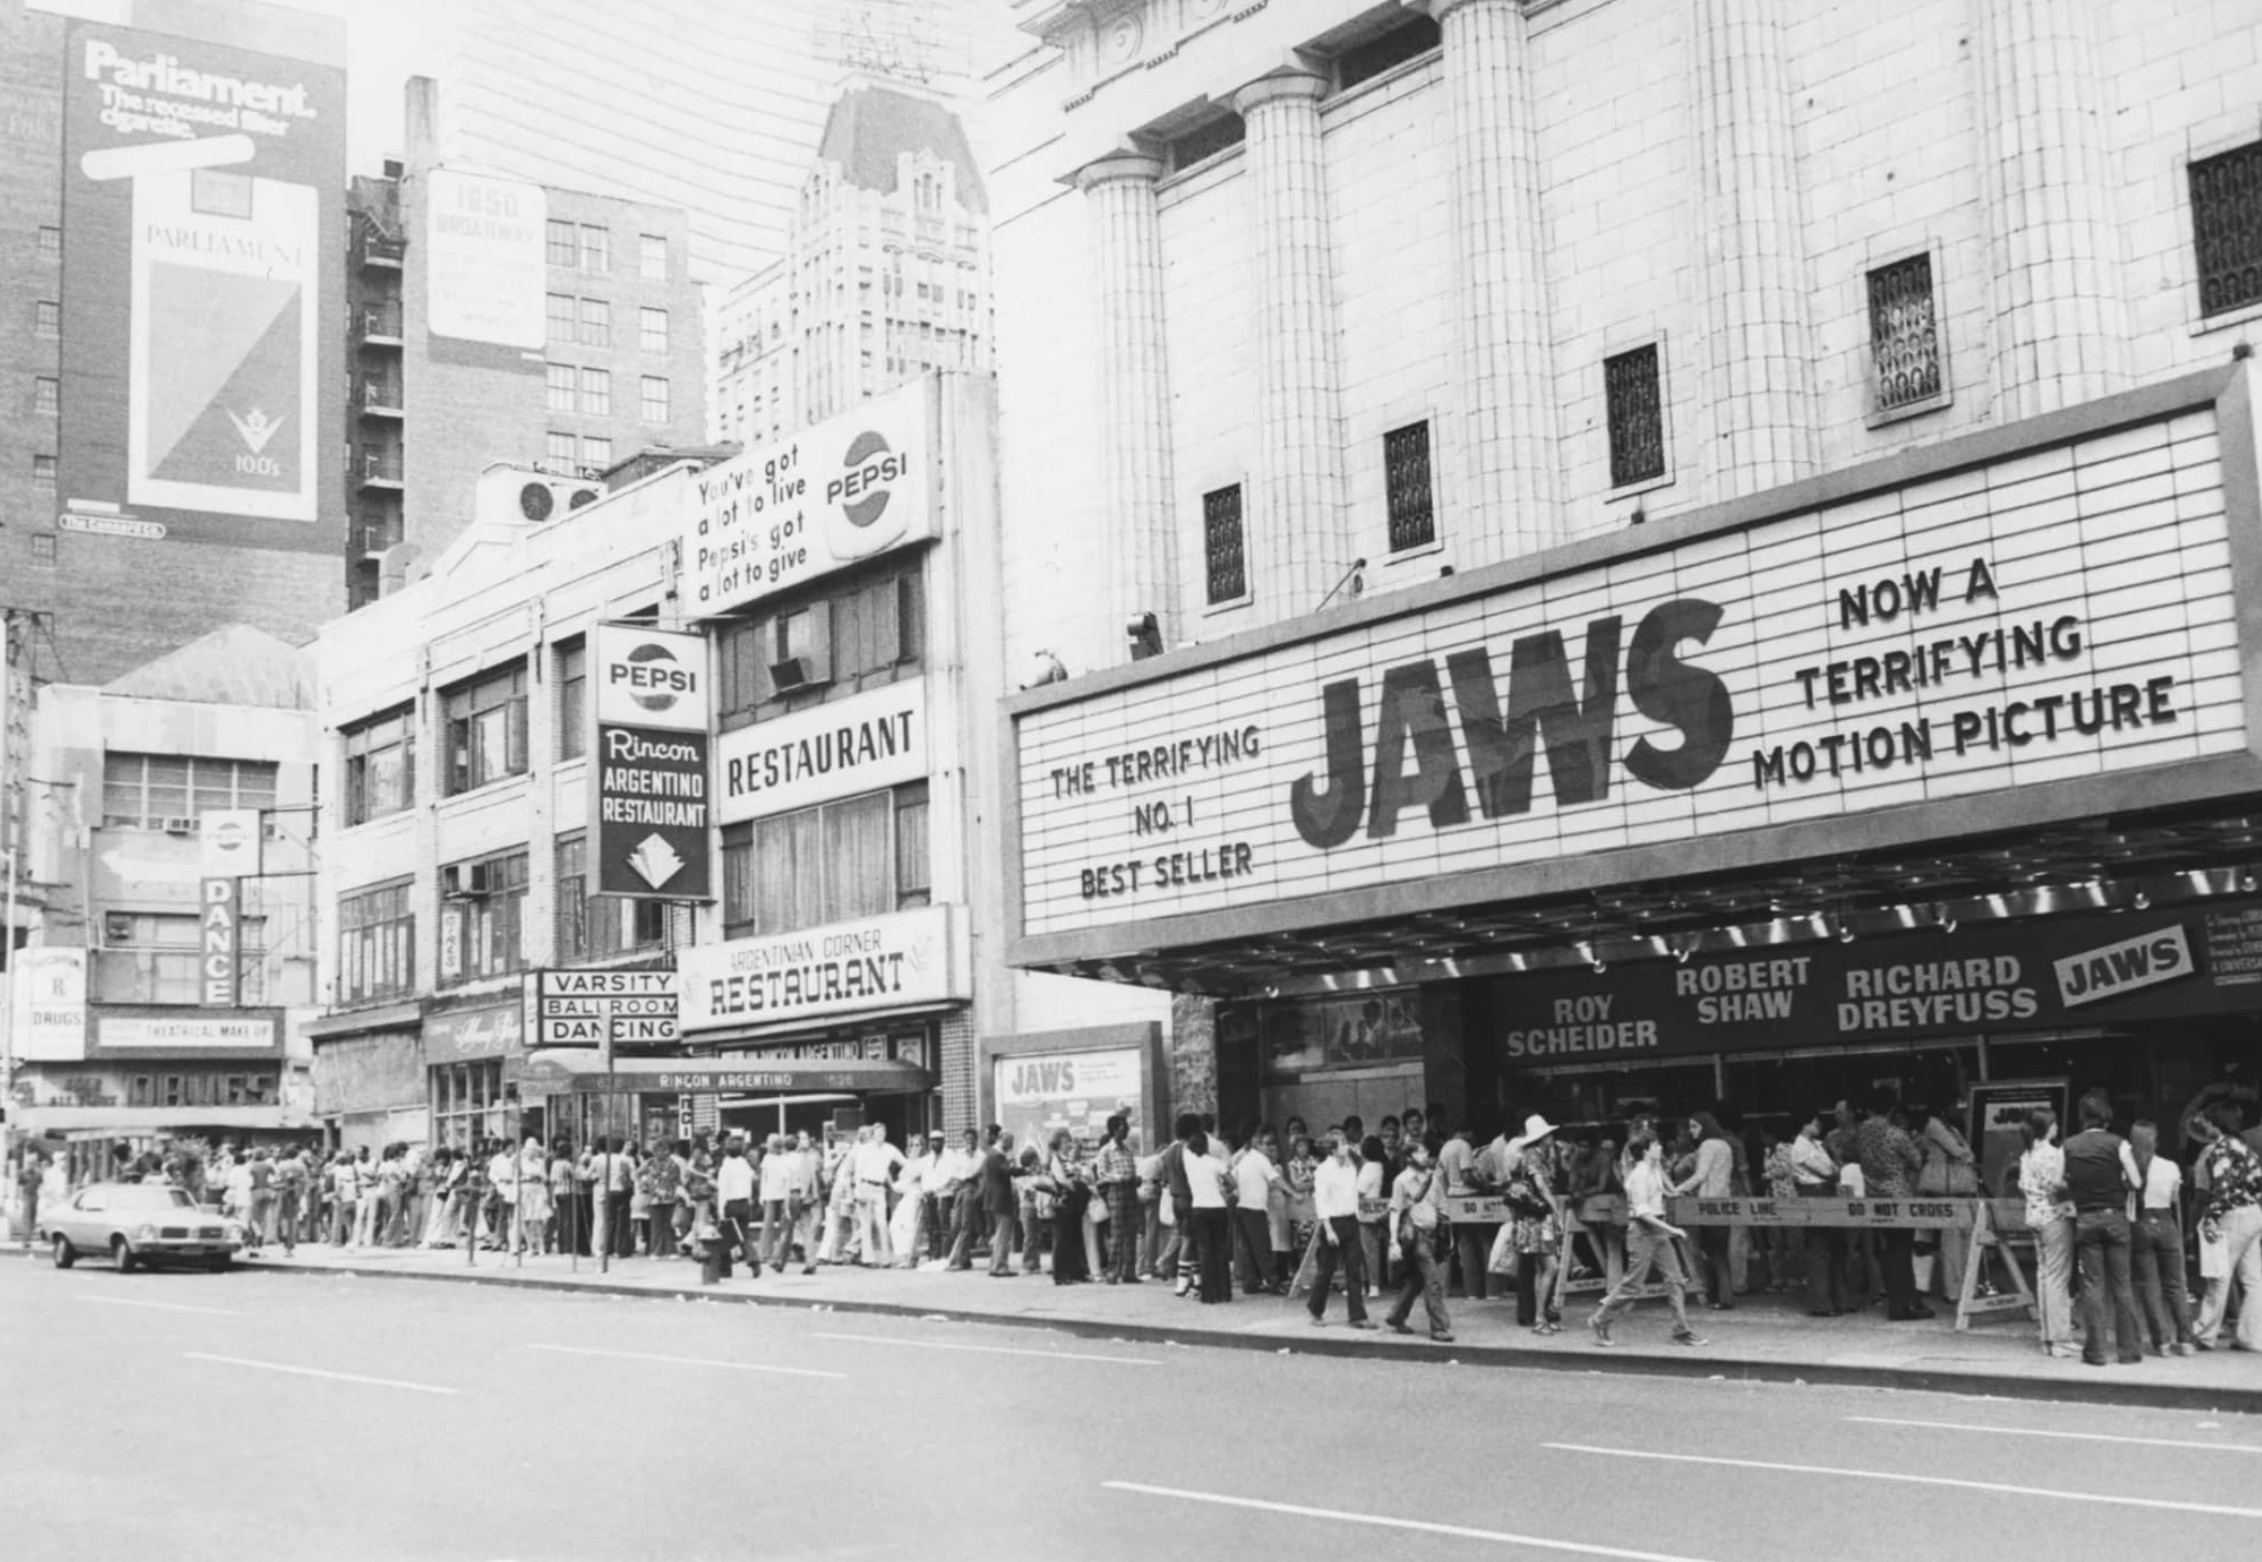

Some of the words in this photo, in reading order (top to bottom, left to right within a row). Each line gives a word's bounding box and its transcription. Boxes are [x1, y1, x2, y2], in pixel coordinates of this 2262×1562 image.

[98, 82, 144, 110] The
[699, 469, 754, 505] You've
[765, 444, 799, 484] got
[827, 452, 907, 505] PEPSI
[699, 518, 709, 535] a
[716, 501, 738, 529] lot
[748, 494, 764, 516] to
[772, 477, 806, 505] live
[699, 530, 758, 572] Pepsi's
[770, 509, 804, 550] got
[699, 584, 710, 602] a
[717, 567, 739, 596] lot
[746, 563, 763, 585] to
[769, 546, 807, 583] give
[1838, 566, 1942, 630] NOW
[1965, 557, 1999, 602] A
[610, 663, 696, 693] PEPSI
[1795, 615, 2082, 709] TERRIFYING
[1290, 599, 1733, 848] JAWS
[1752, 717, 1933, 790] MOTION
[1953, 675, 2178, 756] PICTURE
[605, 729, 700, 762] Rincon
[727, 710, 914, 798] RESTAURANT
[1050, 760, 1096, 799] THE
[1105, 725, 1261, 790] TERRIFYING
[603, 766, 703, 798] ARGENTINO
[602, 797, 706, 828] RESTAURANT
[1135, 803, 1177, 836] NO.
[1081, 859, 1145, 899] BEST
[1154, 842, 1253, 888] SELLER
[205, 880, 232, 1003] DANCE
[824, 929, 882, 959] CORNER
[555, 974, 672, 992] VARSITY
[709, 951, 904, 1016] RESTAURANT
[1676, 957, 1811, 996] ROBERT
[1846, 955, 2021, 998] RICHARD
[2065, 936, 2182, 998] JAWS
[33, 1011, 82, 1026] DRUGS
[1554, 994, 1613, 1025] ROY
[1697, 990, 1793, 1024] SHAW
[1838, 987, 2038, 1031] DREYFUSS
[146, 1024, 213, 1038] THEATRICAL
[220, 1024, 249, 1038] MAKE
[253, 1024, 270, 1038] UP
[553, 1020, 675, 1039] DANCING
[1507, 1020, 1658, 1057] SCHEIDER
[659, 1074, 710, 1088] RINCON
[718, 1074, 793, 1088] ARGENTINO
[1012, 1060, 1075, 1095] JAWS
[1699, 1202, 1740, 1216] POLICE
[1750, 1202, 1778, 1216] LINE
[1849, 1202, 1865, 1217] DO
[1874, 1202, 1899, 1217] NOT
[1909, 1203, 1954, 1218] CROSS
